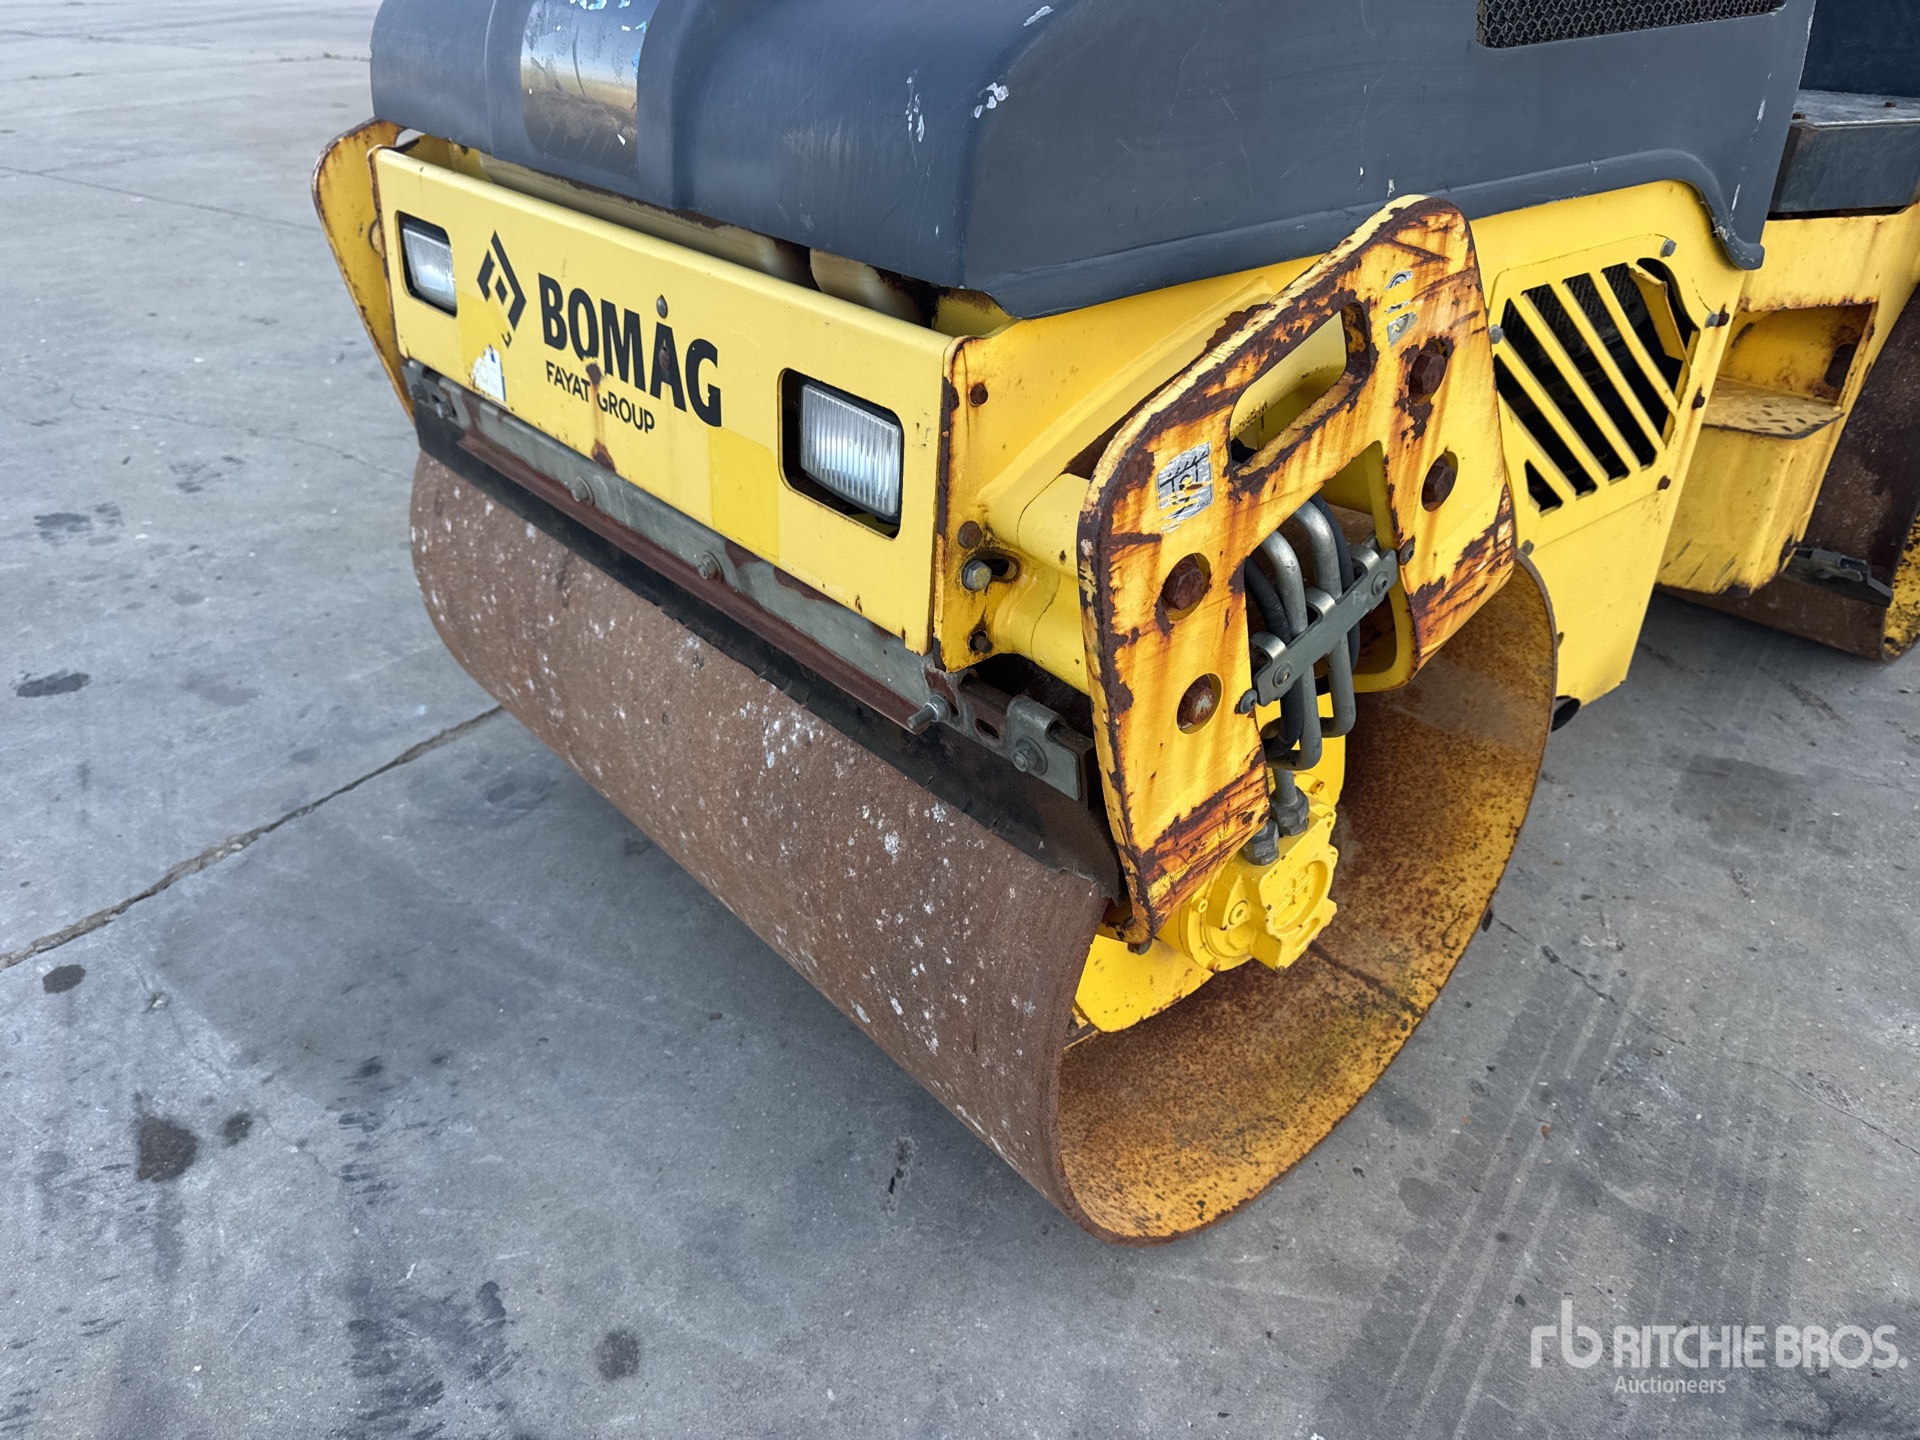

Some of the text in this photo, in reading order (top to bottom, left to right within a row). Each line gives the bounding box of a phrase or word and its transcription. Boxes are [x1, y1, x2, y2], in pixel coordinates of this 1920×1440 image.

[538, 272, 722, 427] BOMAG
[546, 360, 655, 434] FAYAT GROUP
